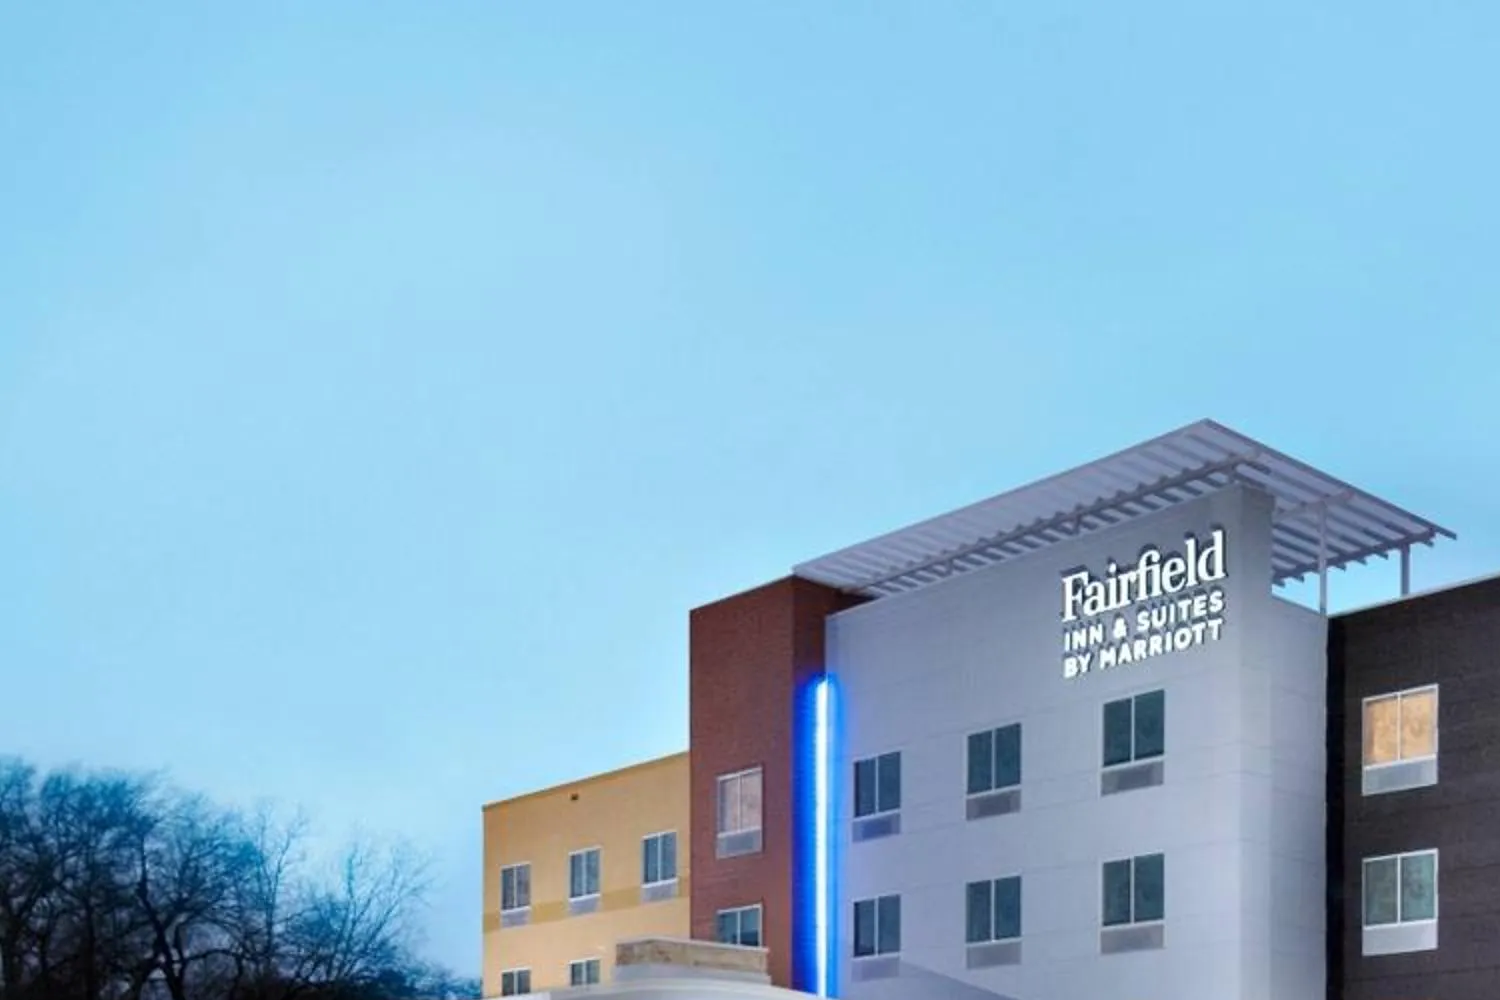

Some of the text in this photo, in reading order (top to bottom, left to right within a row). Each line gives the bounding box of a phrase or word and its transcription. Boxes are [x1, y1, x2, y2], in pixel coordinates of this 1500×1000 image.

[1061, 529, 1227, 622] Fairfield
[1063, 618, 1225, 679] BY MARRIOTT
[1064, 590, 1225, 652] INN & SUITES
